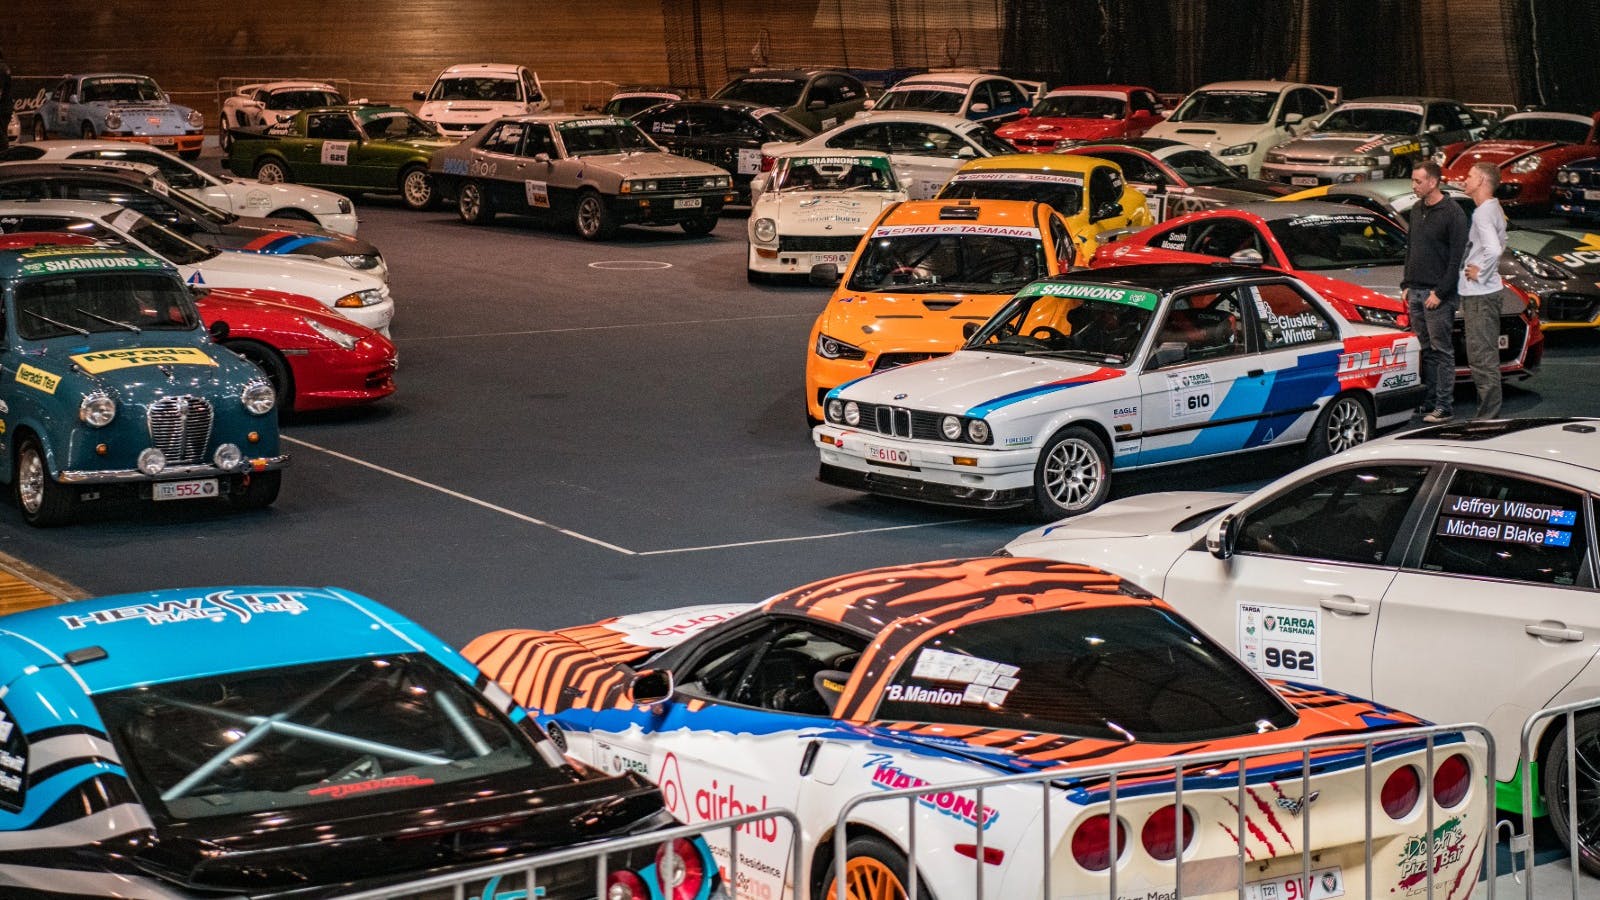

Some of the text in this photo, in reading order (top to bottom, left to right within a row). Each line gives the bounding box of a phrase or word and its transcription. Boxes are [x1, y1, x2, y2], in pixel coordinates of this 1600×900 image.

[807, 157, 860, 165] SHANNONS
[969, 173, 1004, 181] SPIRIT
[1021, 174, 1077, 184] ASMANIA
[892, 226, 940, 234] SPIRIT
[960, 226, 1033, 237] TASMANIA
[1169, 233, 1187, 242] Smith
[45, 257, 139, 272] SHANNONS
[1040, 284, 1126, 301] SHANNONS
[1278, 312, 1318, 330] Gluskie
[1282, 328, 1317, 343] Winter
[83, 348, 196, 362] Nerada
[121, 355, 178, 364] Tea
[1338, 343, 1408, 373] DLM
[19, 367, 56, 390] Nerada Tea
[1188, 372, 1210, 381] TARGA
[1187, 393, 1210, 410] 610
[1113, 406, 1137, 415] EAGLE
[879, 448, 898, 462] 610
[176, 483, 201, 497] 552
[1452, 496, 1550, 521] Jeffrey Wilson
[1446, 519, 1544, 543] Michael Blake
[1277, 615, 1315, 629] TARGA
[1279, 626, 1315, 636] TASMANIA
[1265, 647, 1315, 672] 962
[888, 685, 963, 705] B.Manion
[622, 757, 649, 774] TARGA
[695, 779, 777, 843] airbnb
[1440, 846, 1464, 868] Bar
[739, 853, 781, 879] Residence
[1262, 886, 1276, 897] T21
